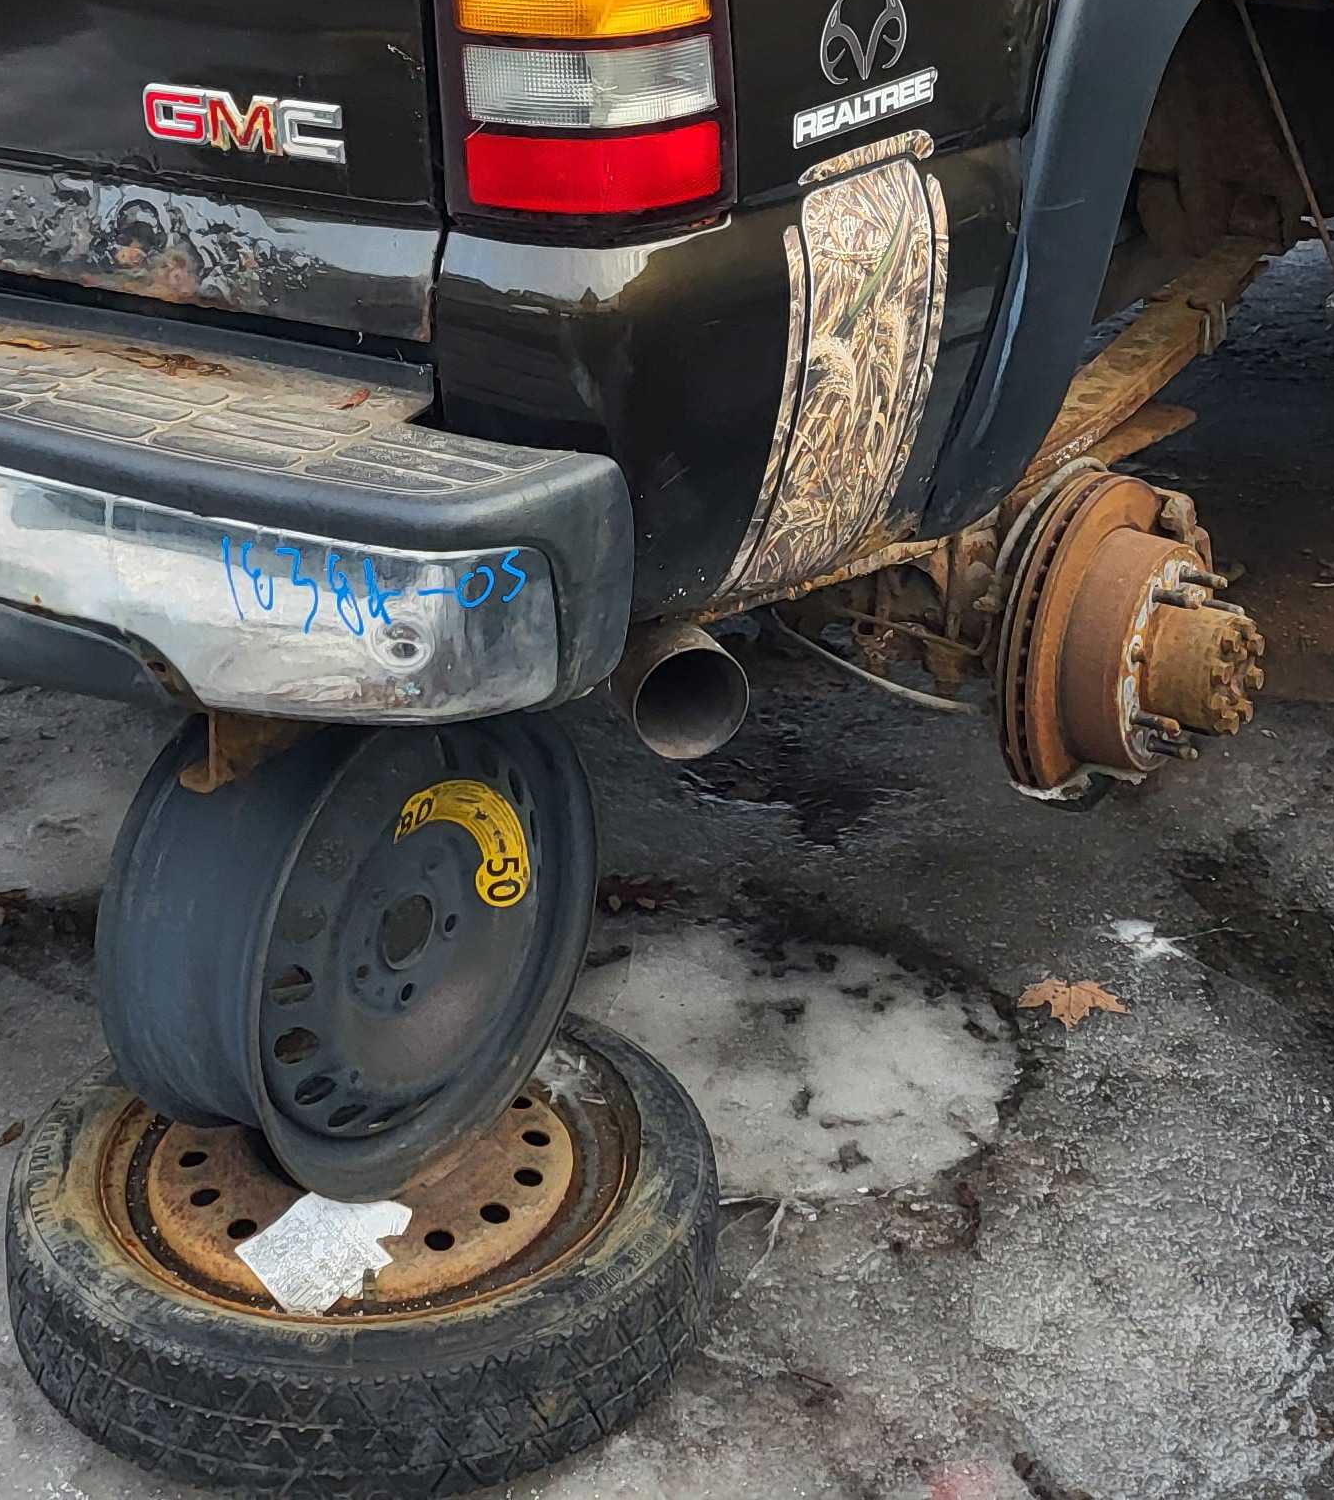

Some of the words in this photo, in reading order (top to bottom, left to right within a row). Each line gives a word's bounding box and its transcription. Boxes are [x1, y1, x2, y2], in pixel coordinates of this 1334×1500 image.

[142, 82, 347, 164] GMC
[795, 71, 933, 144] REALTREE
[486, 856, 521, 902] 50
